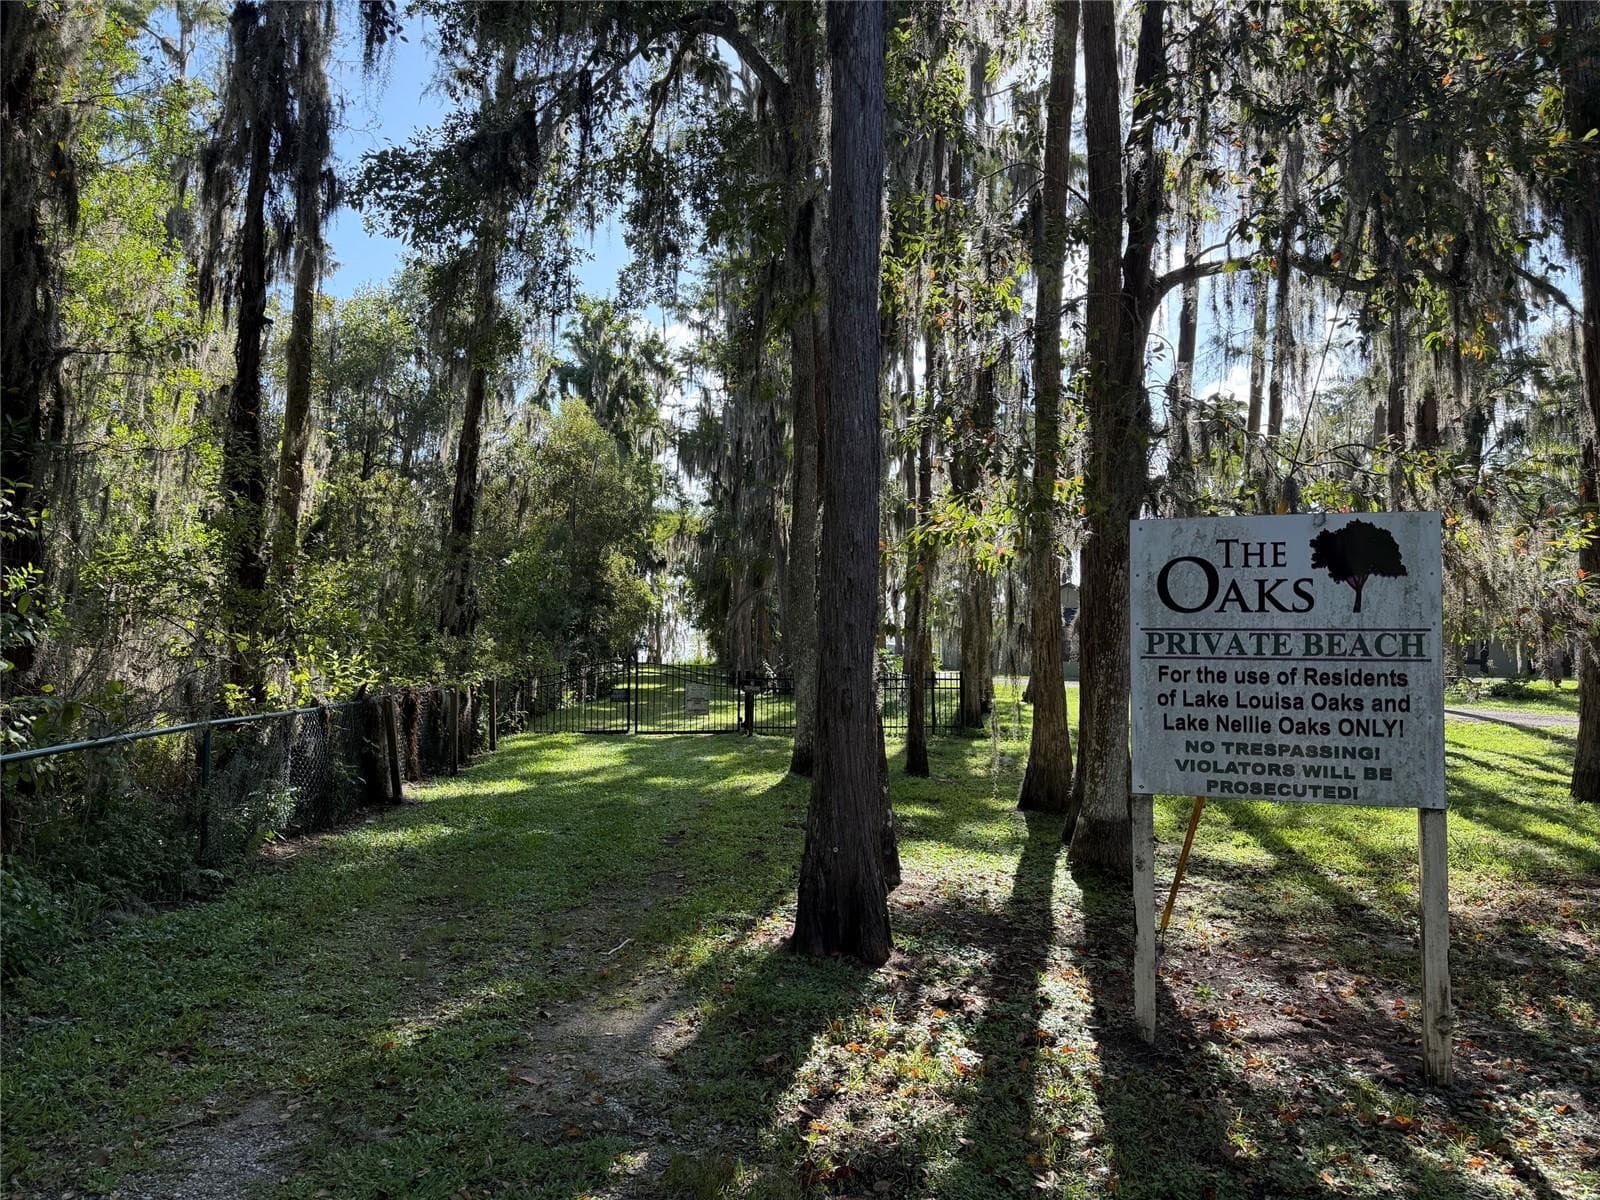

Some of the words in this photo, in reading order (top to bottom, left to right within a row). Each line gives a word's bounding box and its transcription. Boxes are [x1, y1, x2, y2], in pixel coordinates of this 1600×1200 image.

[1145, 632, 1292, 656] PRIVATE
[1302, 632, 1426, 657] BEACH
[1158, 665, 1191, 683] For
[1197, 666, 1227, 685] the
[1234, 670, 1270, 685] use
[1277, 667, 1298, 686] of
[1157, 689, 1177, 707] of
[1182, 690, 1229, 708] Lake
[1236, 691, 1304, 711] Louisa
[1311, 692, 1364, 712] Oaks
[1371, 694, 1410, 713] and
[1163, 713, 1209, 732] Lake
[1278, 716, 1331, 736] Oaks
[1338, 718, 1404, 738] ONLY!
[1185, 740, 1215, 754] NO
[1221, 741, 1380, 761] TRESPASSING!
[1174, 759, 1295, 778] VIOLATORS
[1302, 764, 1356, 780] WILL
[1363, 767, 1393, 781] BE
[1206, 780, 1358, 800] PROSECUTED!
